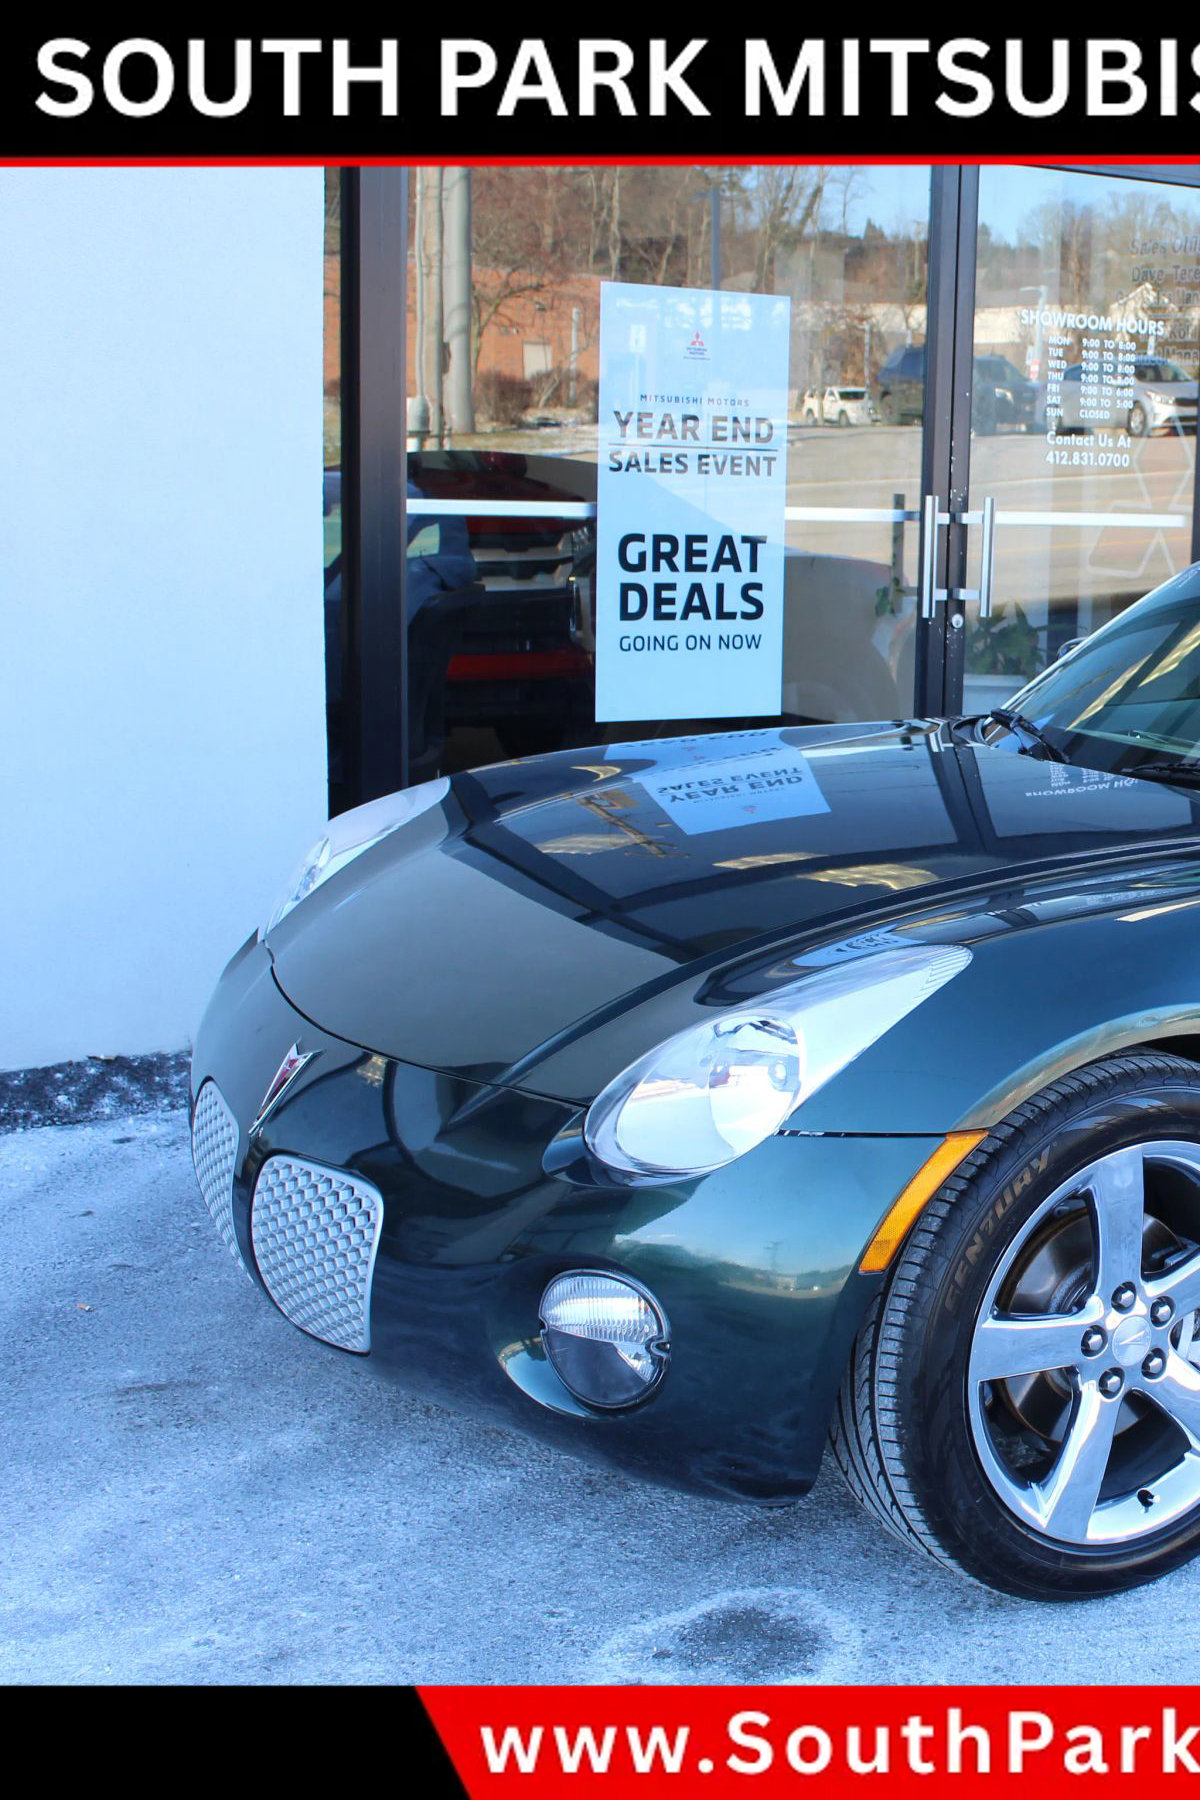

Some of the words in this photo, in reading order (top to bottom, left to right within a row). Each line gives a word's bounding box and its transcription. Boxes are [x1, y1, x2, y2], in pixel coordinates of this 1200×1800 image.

[1021, 309, 1112, 331] SHOWROOM
[1116, 318, 1165, 335] HOURS
[1048, 336, 1070, 346] MON
[1082, 339, 1100, 348] 9:00
[1103, 340, 1115, 348] TO
[1048, 348, 1064, 357] TUE
[1081, 351, 1099, 359] 9:00
[1103, 352, 1113, 360] TO
[1048, 360, 1067, 369] WED
[1080, 362, 1099, 371] 9:00
[1103, 364, 1113, 372] TO
[1047, 372, 1064, 381] THU
[1080, 374, 1098, 383] 9:00
[1102, 375, 1113, 383] TO
[1047, 384, 1060, 392] FRI
[1080, 386, 1097, 395] 9:00
[1102, 387, 1112, 395] TO
[640, 394, 703, 405] MITSUBISHI
[707, 397, 750, 407] MOTORS
[1046, 396, 1061, 405] SAT
[1079, 398, 1097, 407] 9:00
[1100, 399, 1111, 407] TO
[1046, 408, 1064, 417] SUN
[1080, 410, 1110, 419] CLOSED
[613, 411, 700, 441] YEAR
[711, 415, 774, 444] END
[1046, 431, 1095, 447] Contact
[1098, 435, 1113, 447] Us
[1117, 435, 1131, 448] At
[609, 451, 689, 474] SALES
[697, 454, 777, 477] EVENT
[1046, 451, 1130, 467] 412.831.0700
[618, 533, 767, 573] GREAT
[619, 582, 764, 621] DEALS
[619, 635, 679, 652] GOING
[685, 635, 711, 651] ON
[719, 634, 762, 650] NOW
